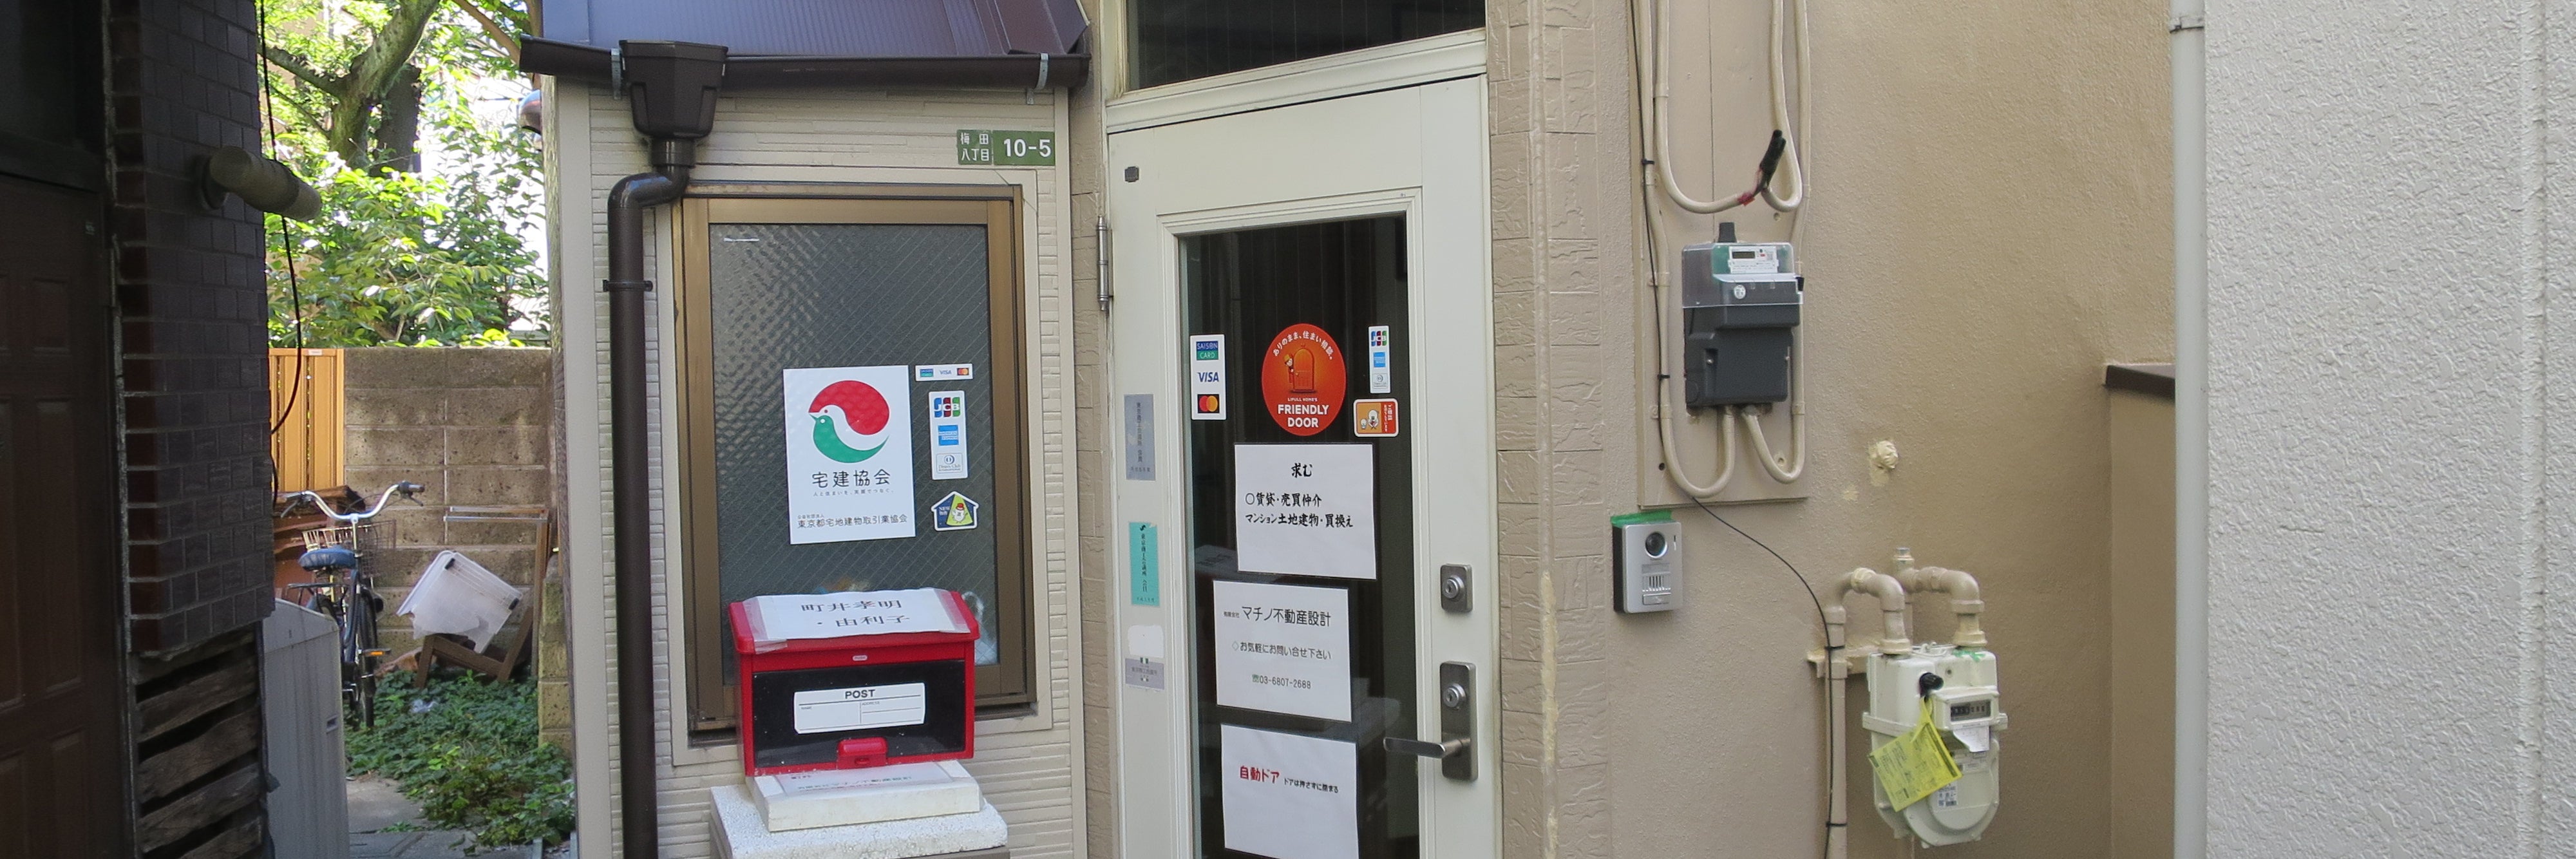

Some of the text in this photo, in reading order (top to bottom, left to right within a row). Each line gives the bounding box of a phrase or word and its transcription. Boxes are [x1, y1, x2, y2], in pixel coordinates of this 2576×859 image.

[960, 133, 989, 145] 梅田
[1003, 138, 1051, 157] 10-5
[961, 149, 989, 161] 八丁目
[1197, 372, 1220, 382] VISA
[1278, 404, 1329, 415] FRIENDLY
[1287, 417, 1319, 428] DOOR
[1291, 463, 1312, 478] 求む
[812, 469, 891, 488] 宅建協会
[797, 514, 907, 529] 東京都宅地建物取引業協会
[1242, 607, 1331, 627] マチノ不動産設計
[845, 689, 875, 699] POST
[1240, 766, 1280, 784] 自動ドア
